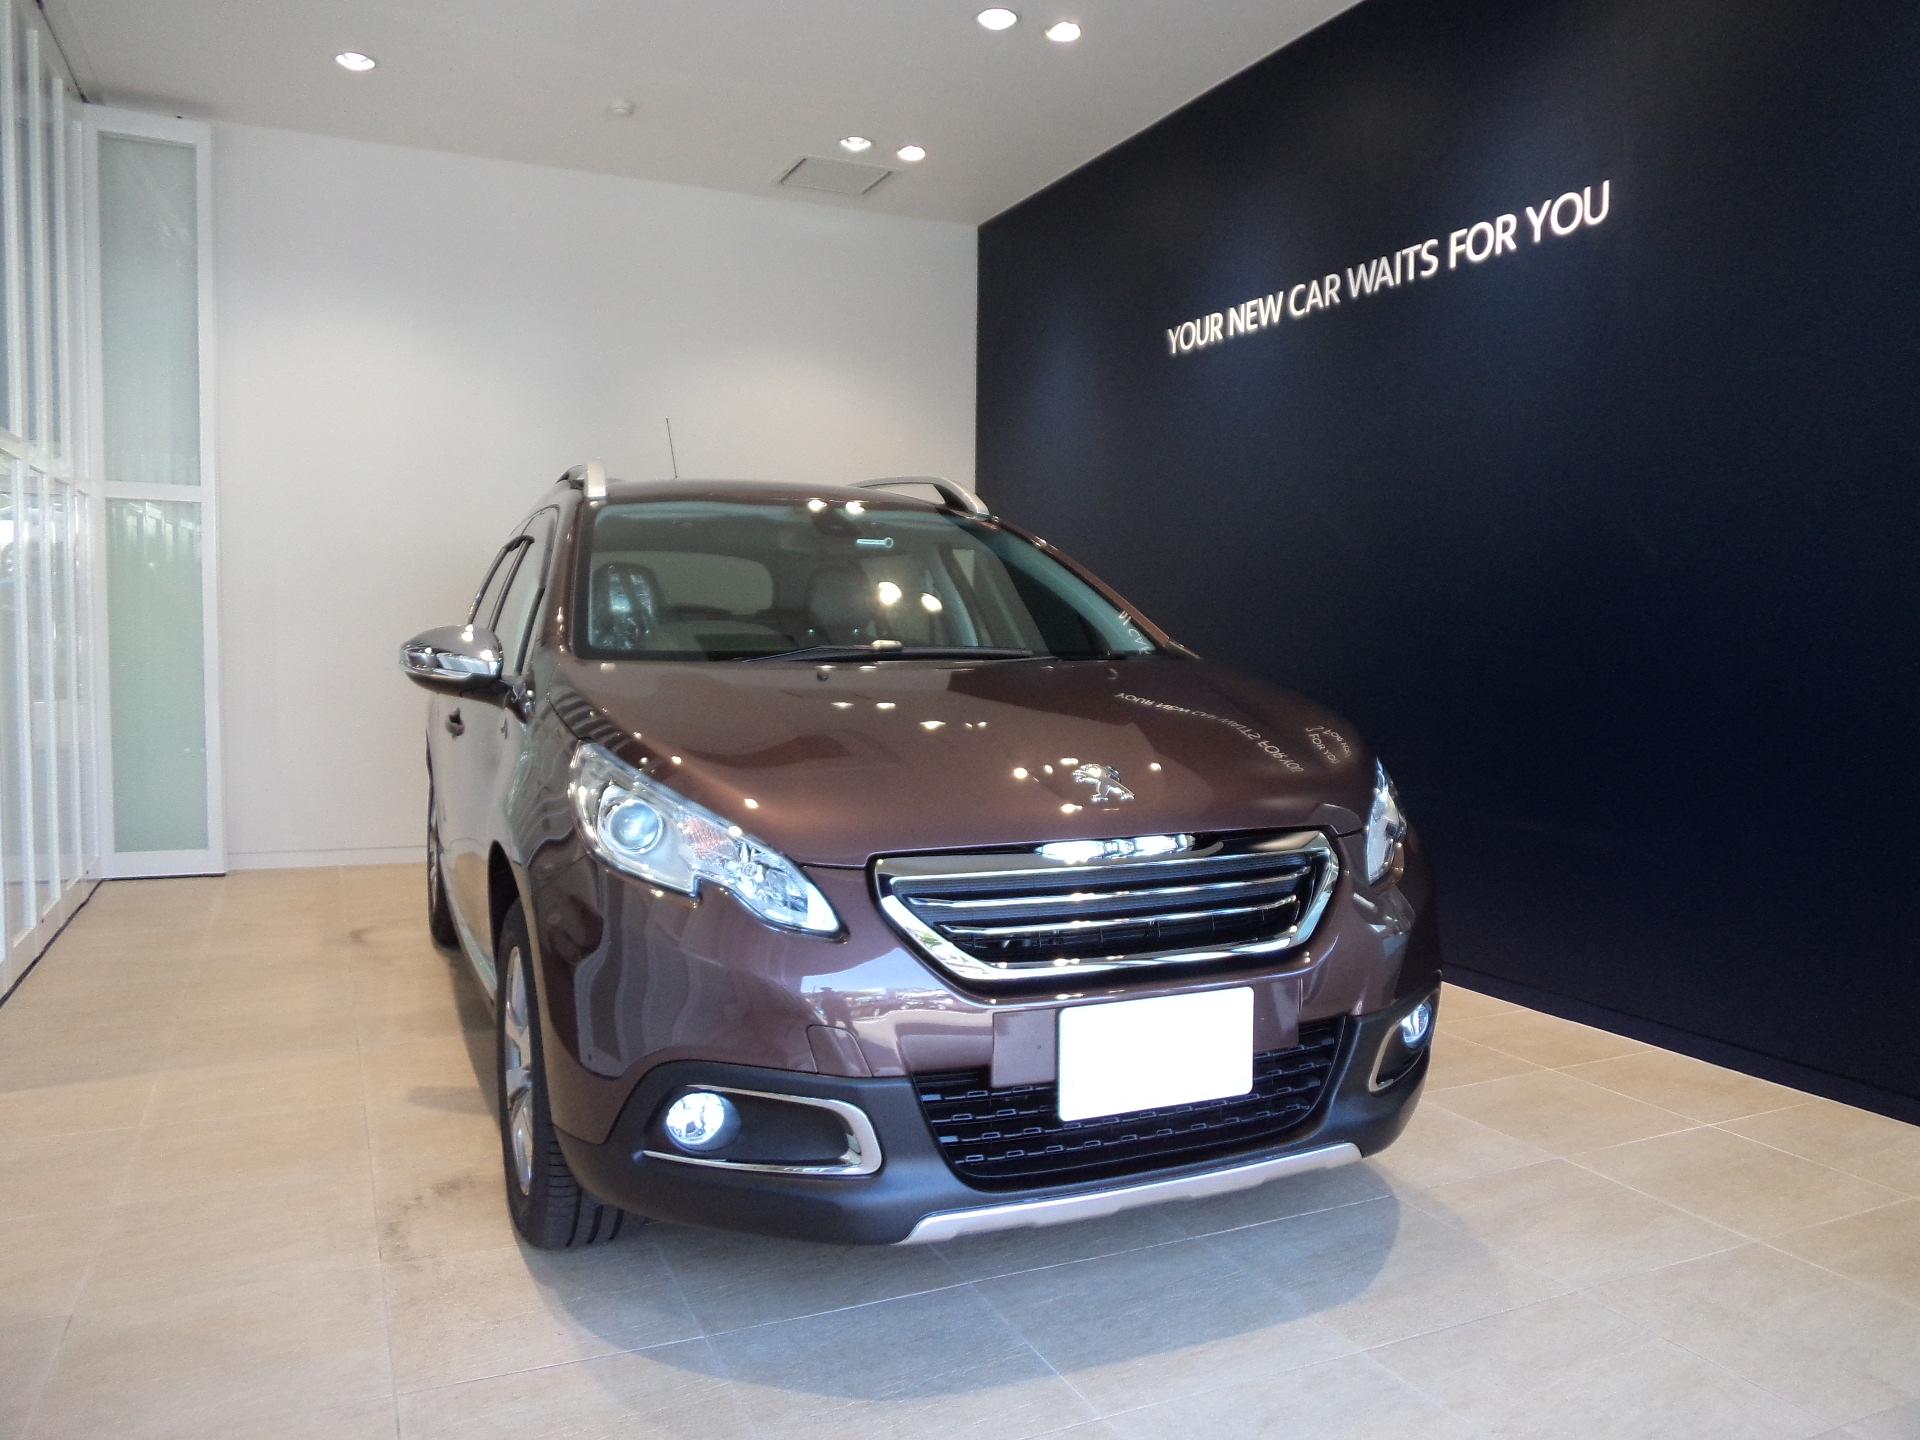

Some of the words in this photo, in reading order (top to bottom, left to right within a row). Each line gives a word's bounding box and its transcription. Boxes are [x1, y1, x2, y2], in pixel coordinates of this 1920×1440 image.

[1167, 312, 1224, 355] YOUR
[1227, 290, 1284, 338] NEW
[1287, 273, 1341, 318] CAR
[1346, 238, 1438, 298] WAITS
[1448, 213, 1518, 270] FOR
[1524, 179, 1611, 244] YOU
